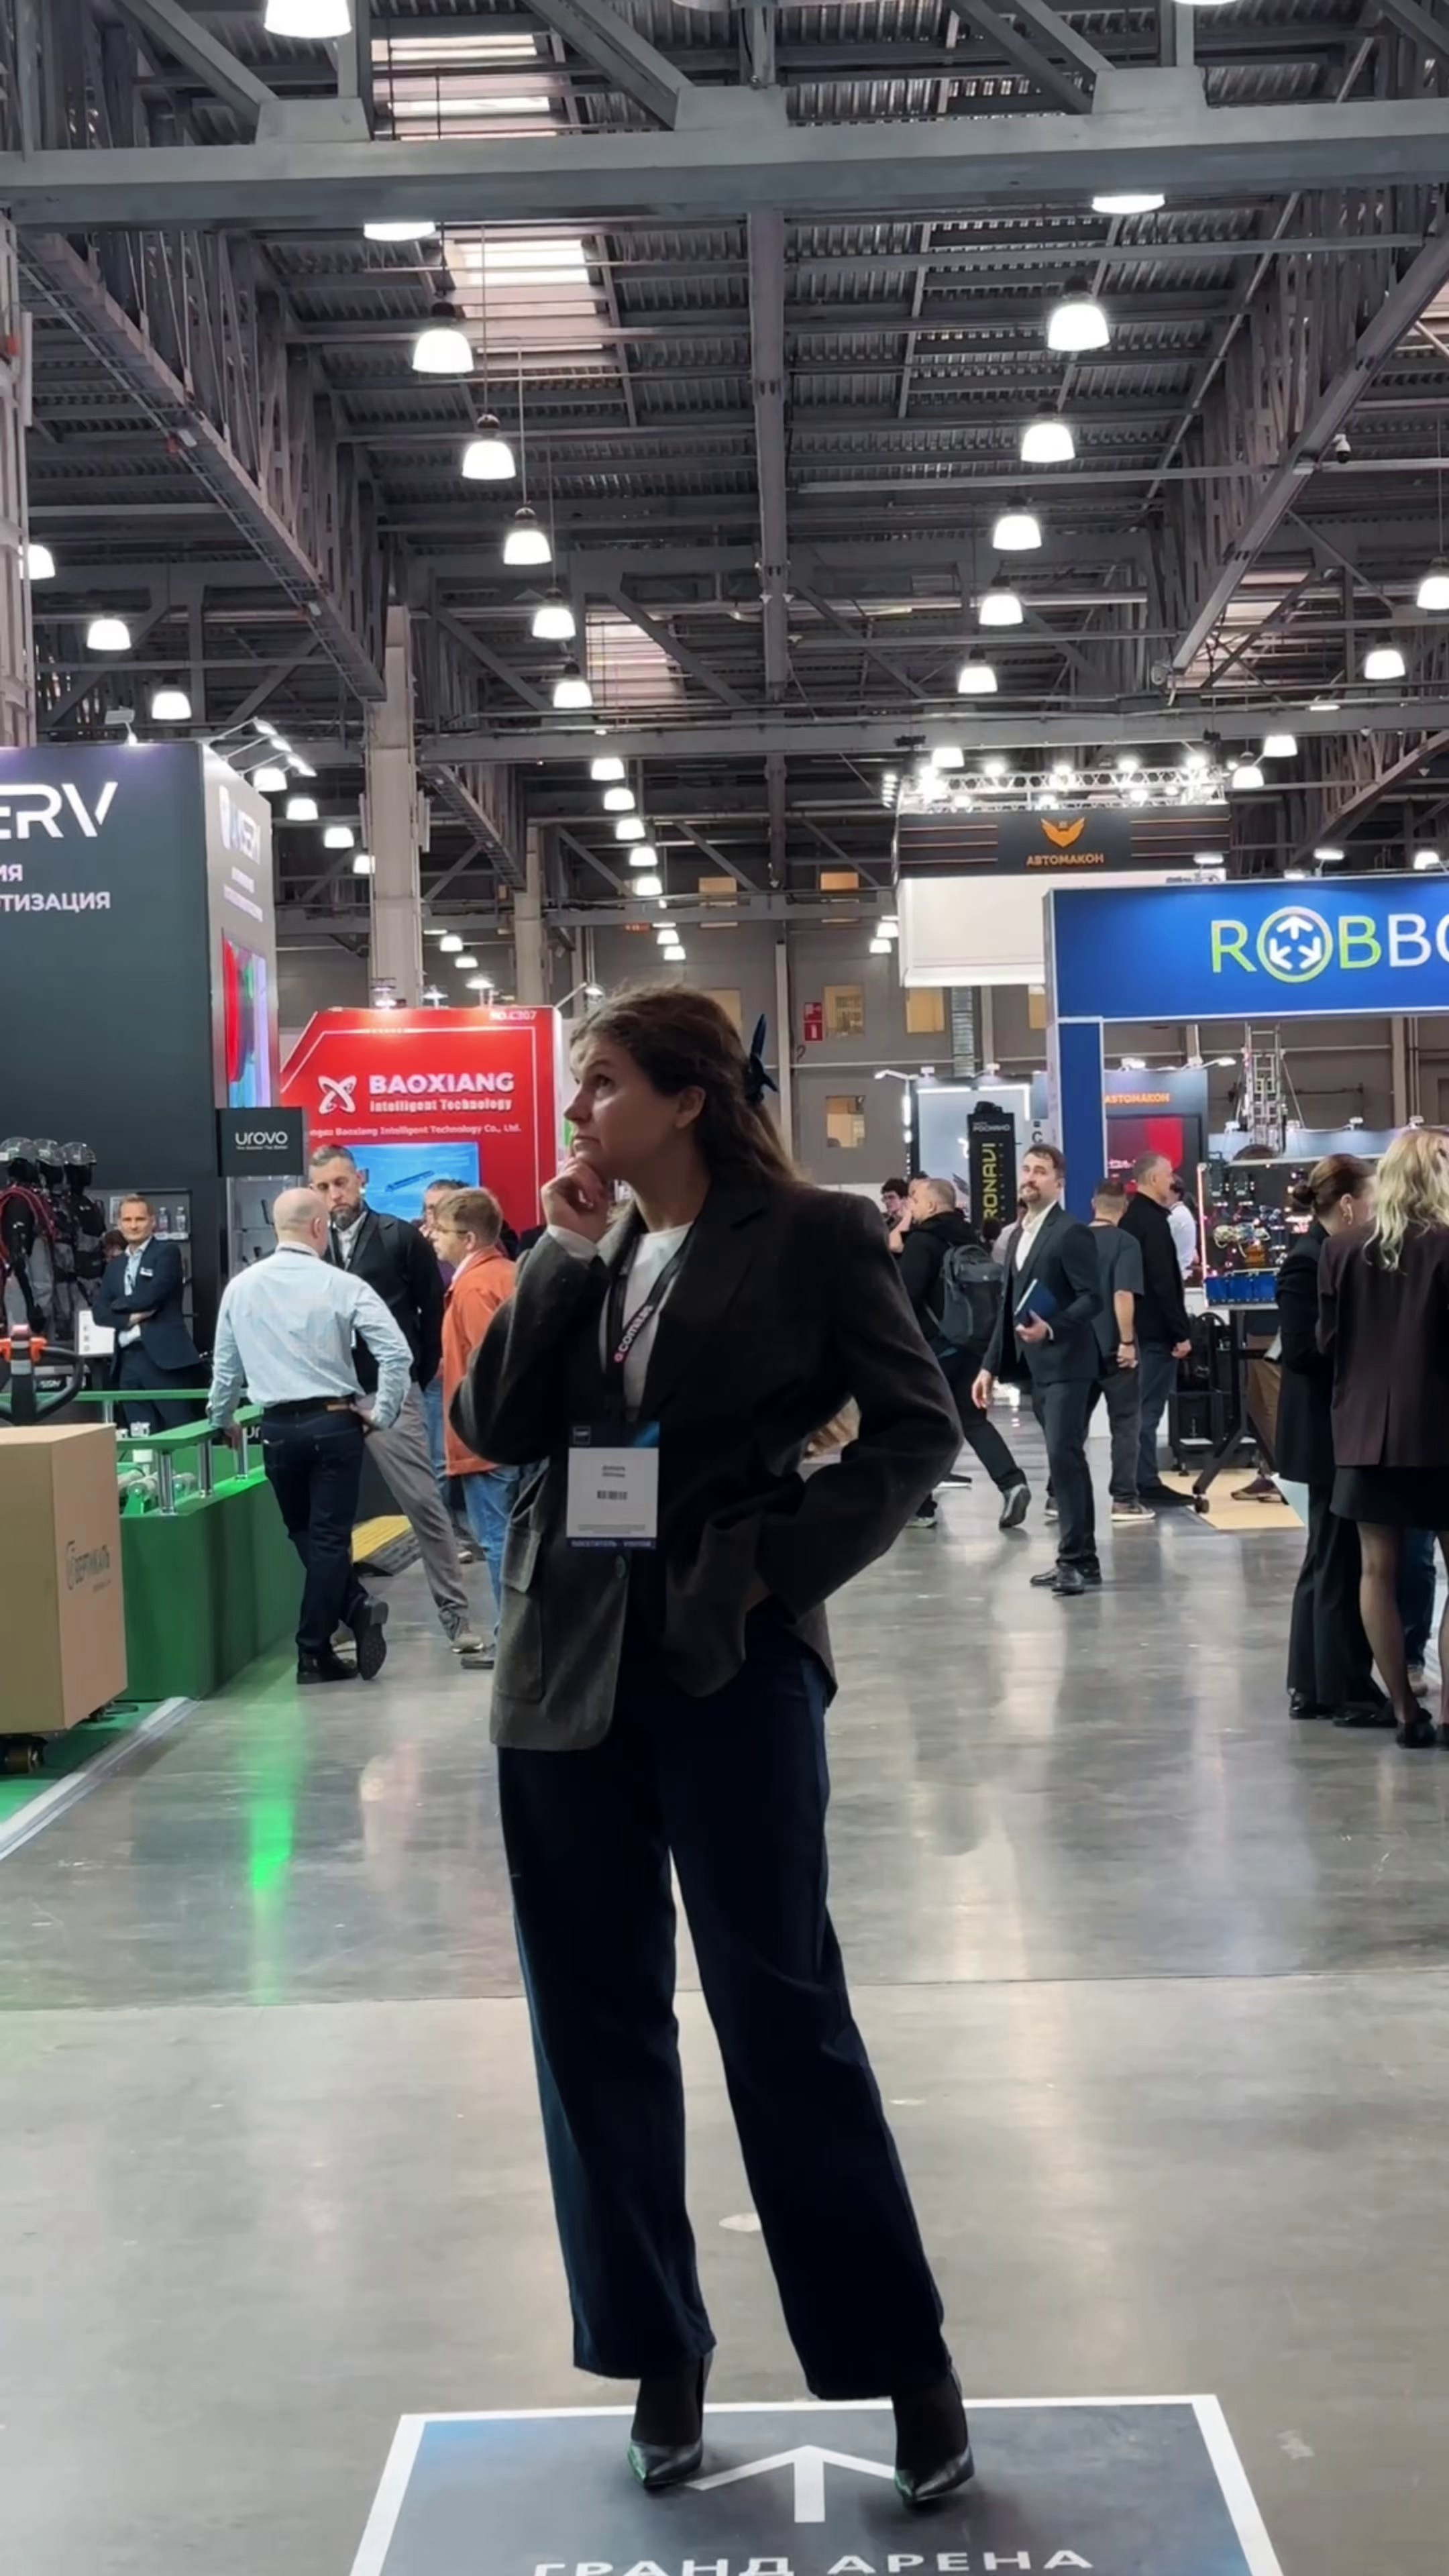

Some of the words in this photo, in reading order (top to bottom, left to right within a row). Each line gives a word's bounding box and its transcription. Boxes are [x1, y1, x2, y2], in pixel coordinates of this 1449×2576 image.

[0, 782, 118, 839] RV
[1026, 853, 1104, 867] АВТОМАКОН
[1211, 906, 1449, 983] ROBB
[370, 1072, 515, 1095] BAOXIANG
[370, 1099, 437, 1113] Intelligent
[439, 1097, 512, 1111] Technology
[235, 1131, 288, 1145] urovo
[380, 1126, 428, 1136] Intelligent
[429, 1124, 482, 1134] Technology
[982, 1142, 998, 1219] RONAVI
[534, 2557, 795, 2576] ГРАНД
[826, 2549, 1094, 2575] АРЕНА
